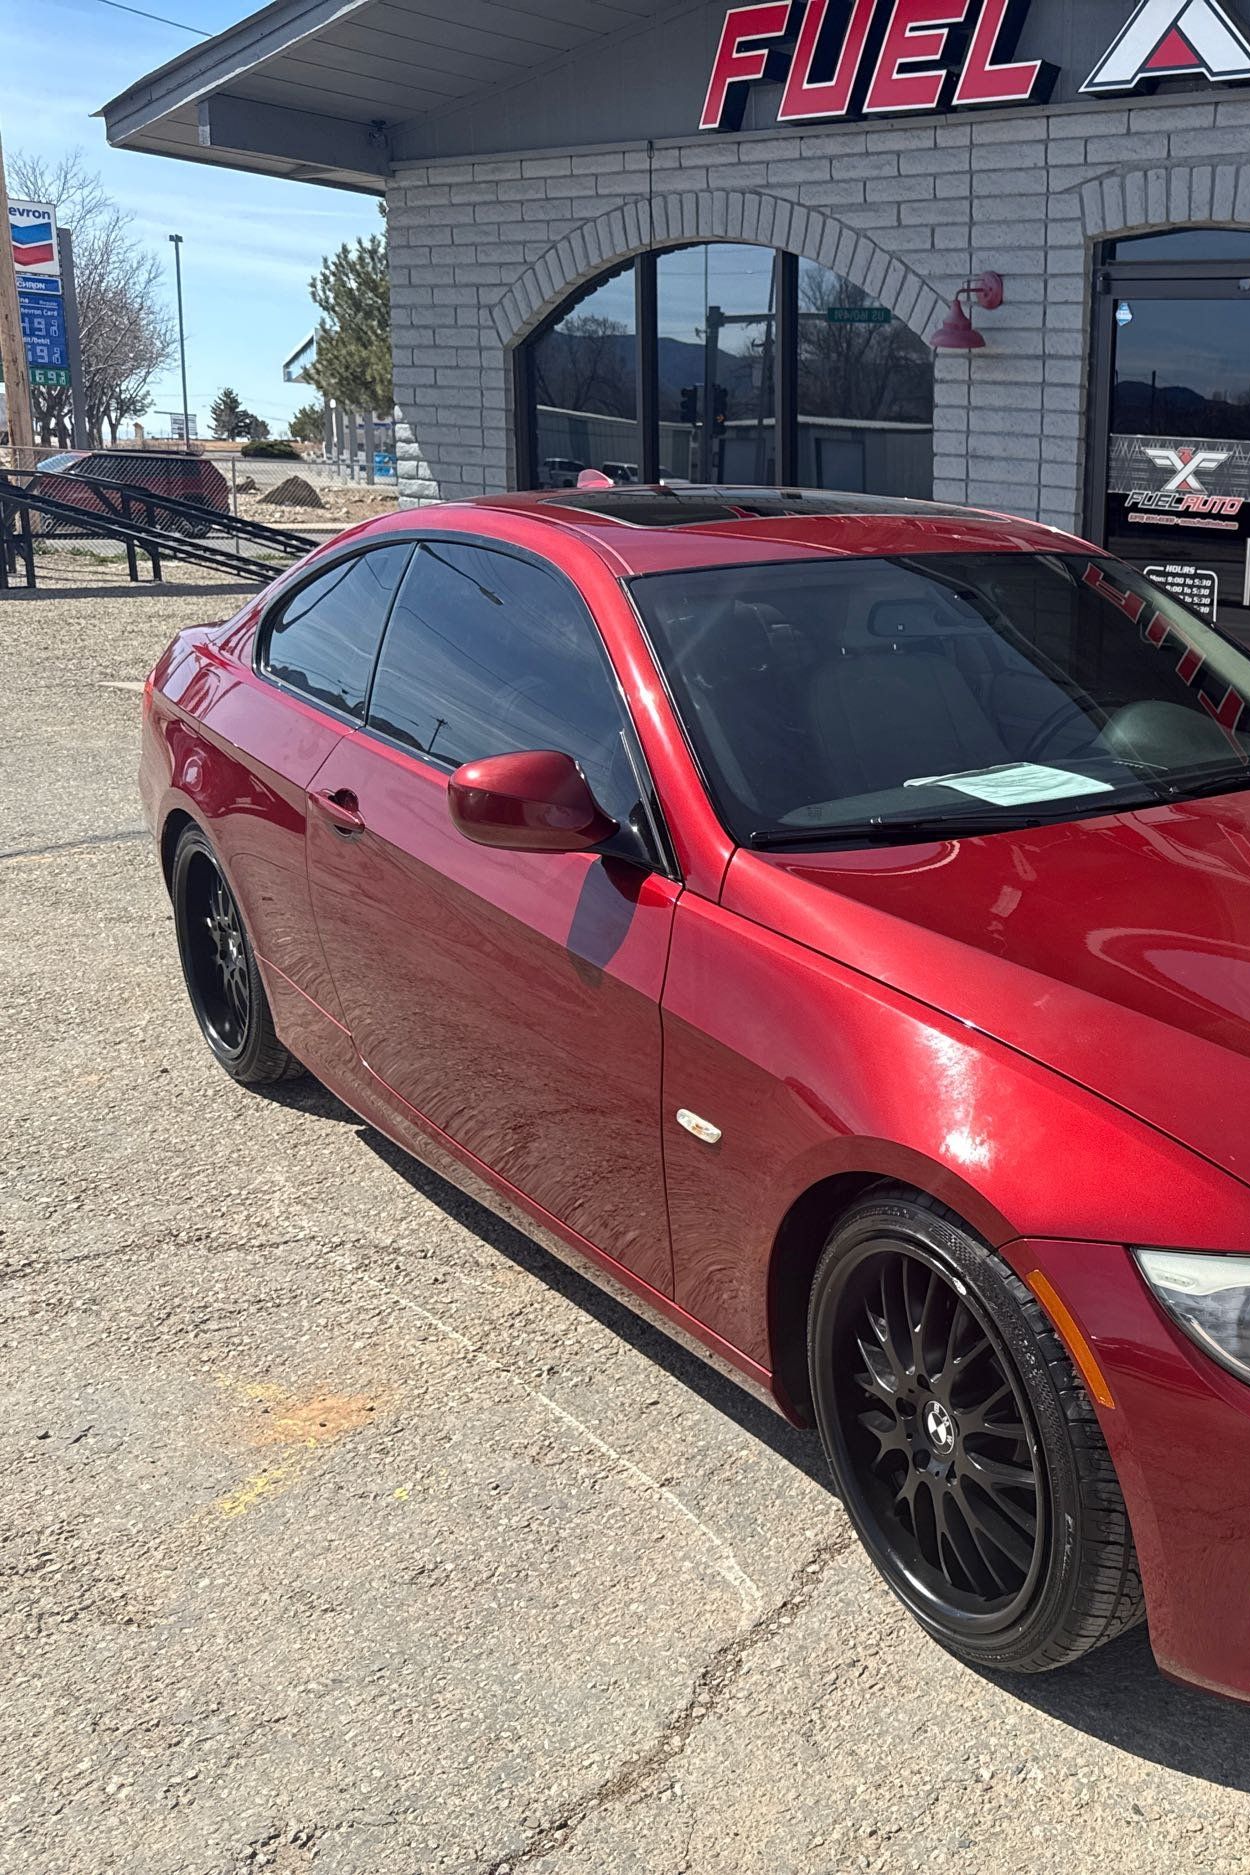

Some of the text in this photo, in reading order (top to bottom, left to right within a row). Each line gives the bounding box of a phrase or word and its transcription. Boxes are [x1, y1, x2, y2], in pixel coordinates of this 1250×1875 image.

[699, 0, 1044, 130] FUEL
[8, 206, 51, 220] evron
[16, 281, 46, 289] CHRON
[1165, 565, 1195, 574] HOURS
[1167, 576, 1184, 584] 9:00
[1193, 579, 1212, 587] 5:30
